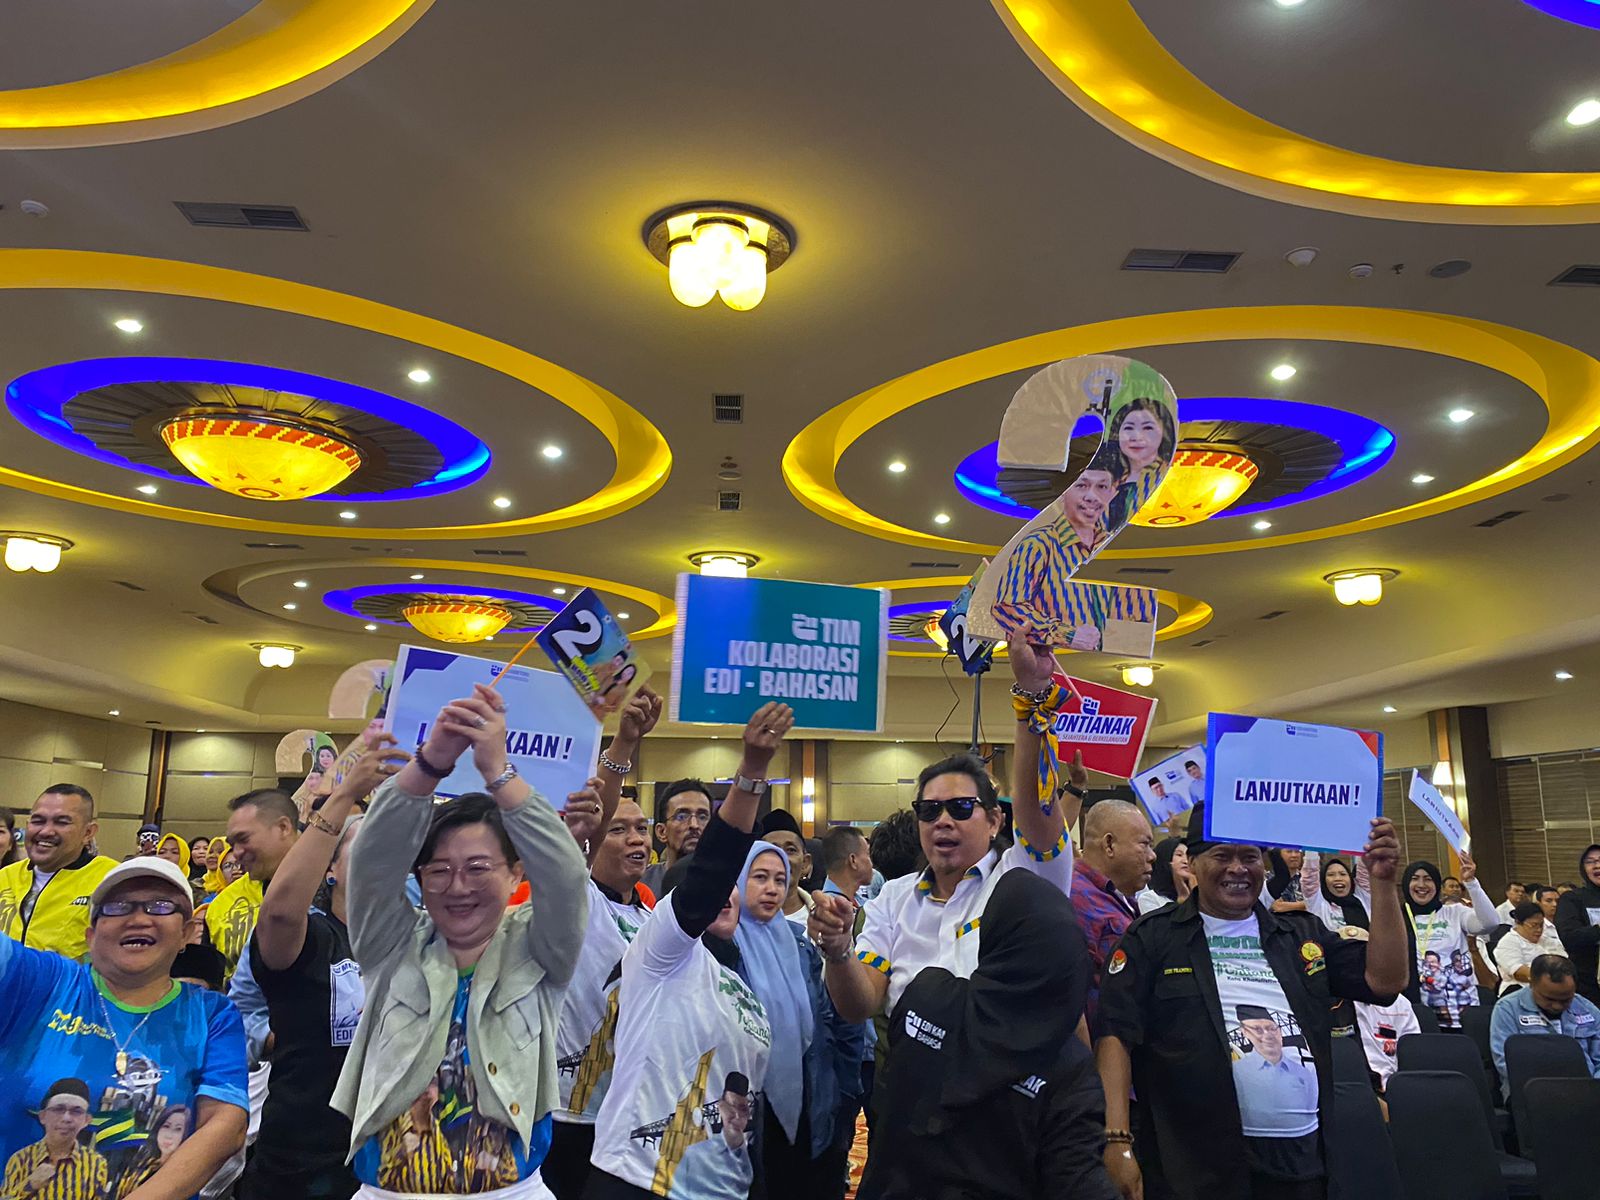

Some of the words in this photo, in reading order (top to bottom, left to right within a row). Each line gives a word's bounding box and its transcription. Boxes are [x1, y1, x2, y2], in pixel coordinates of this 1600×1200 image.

[551, 609, 602, 661] 2
[820, 617, 861, 646] TIM
[728, 639, 860, 674] KOLABORASI
[704, 667, 741, 694] EDI
[759, 670, 859, 702] BAHASAN
[1055, 714, 1135, 735] ONTIANAK
[1235, 780, 1350, 805] LANJUTKAAN
[336, 1029, 353, 1041] EDI
